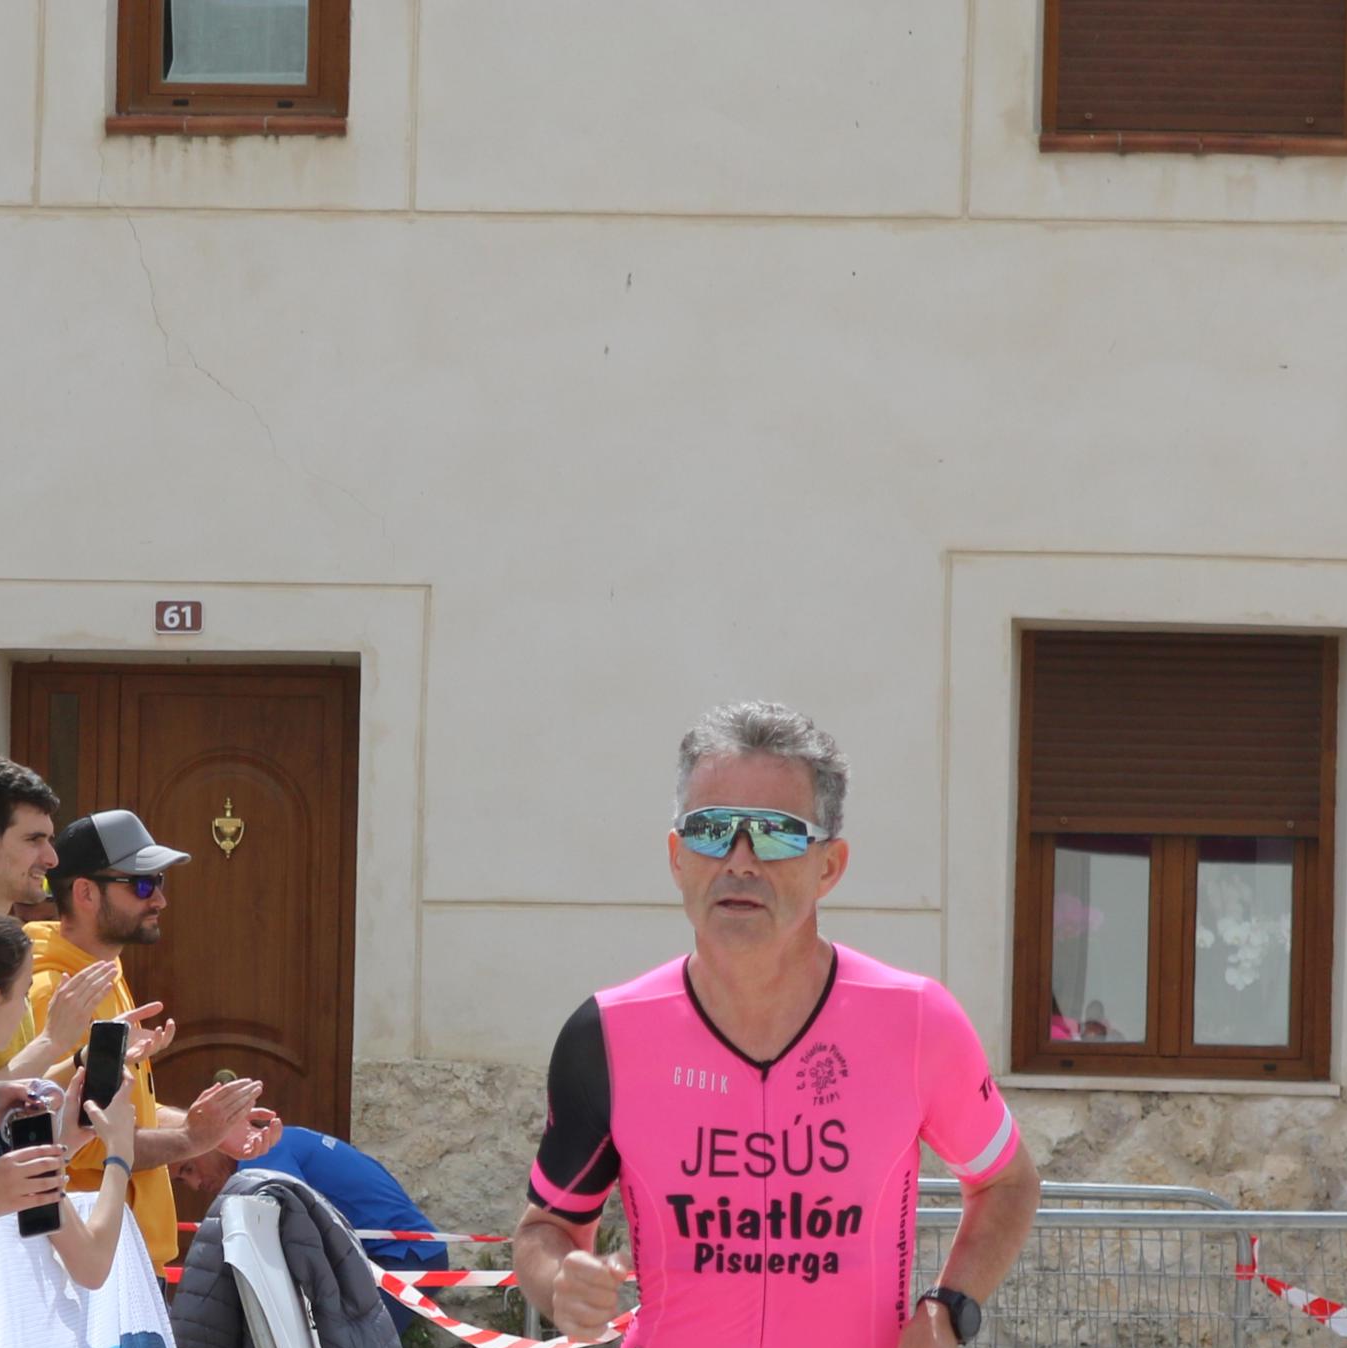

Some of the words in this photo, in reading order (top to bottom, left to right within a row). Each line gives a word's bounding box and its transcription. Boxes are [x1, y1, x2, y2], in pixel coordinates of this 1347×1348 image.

[163, 605, 193, 628] 61
[674, 1066, 728, 1094] GOBIK
[681, 1113, 849, 1178] JESÚS
[666, 1192, 862, 1240] Triatlón
[694, 1243, 839, 1283] Pisuerga
